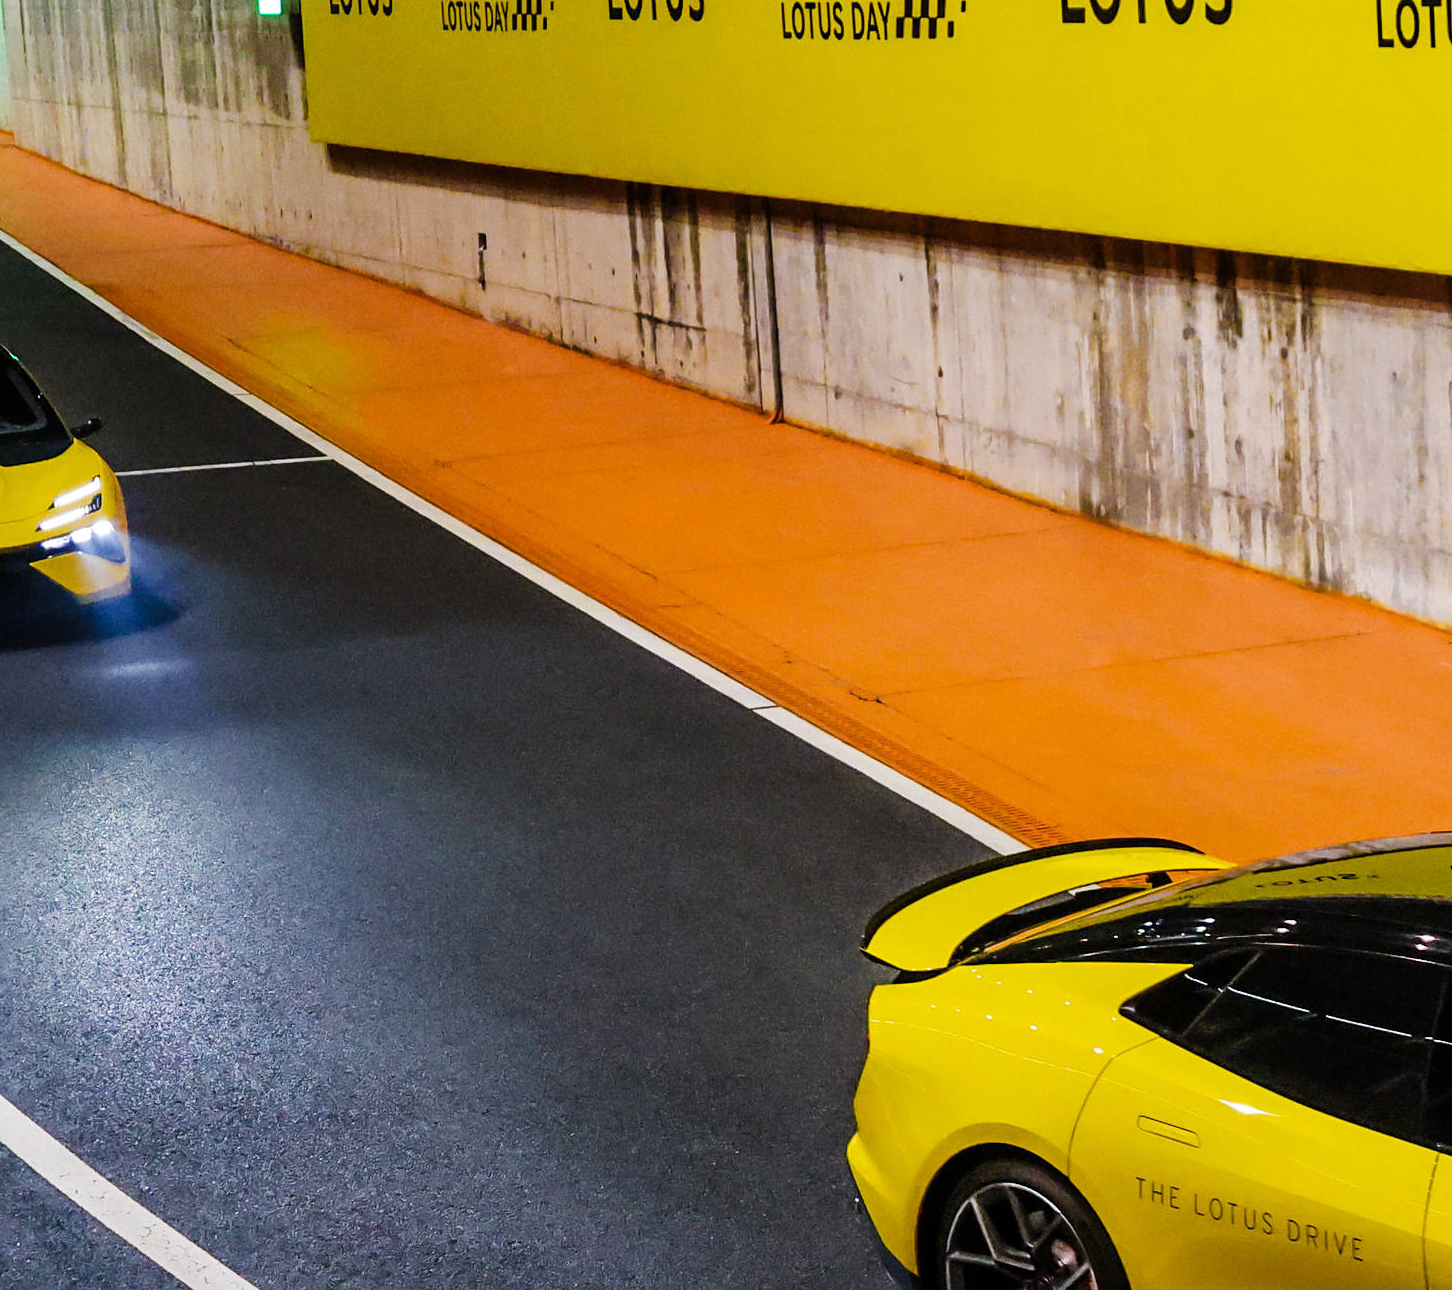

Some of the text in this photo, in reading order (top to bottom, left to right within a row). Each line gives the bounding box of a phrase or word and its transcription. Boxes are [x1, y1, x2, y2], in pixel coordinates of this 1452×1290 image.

[441, 1, 509, 32] LOTUS DAY
[780, 1, 892, 41] LOTUS DAY
[1136, 1176, 1364, 1262] THE LOTUS DRIVE
